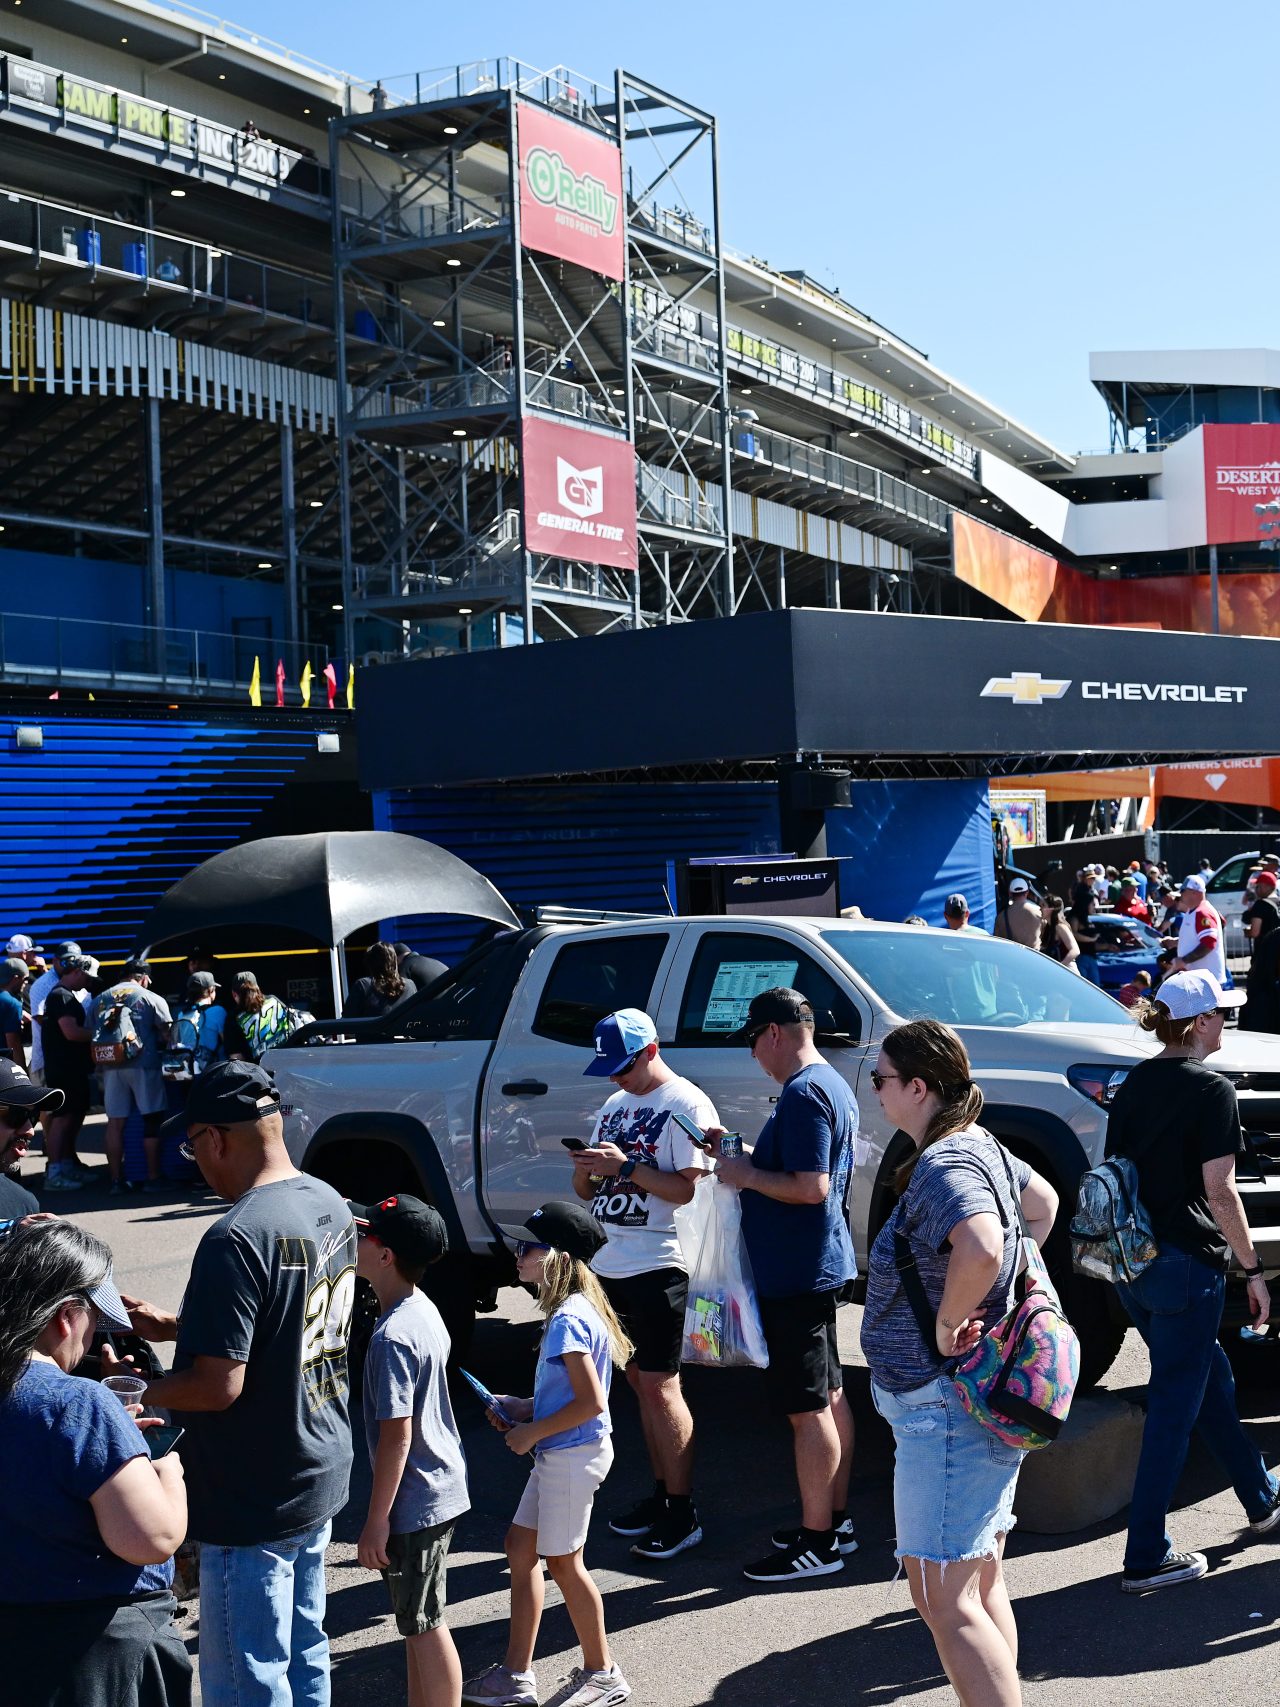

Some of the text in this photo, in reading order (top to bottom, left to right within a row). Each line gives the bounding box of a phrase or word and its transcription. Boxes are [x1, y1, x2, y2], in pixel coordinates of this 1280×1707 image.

[245, 141, 290, 180] 2009
[531, 155, 613, 227] O'Reilly
[1236, 486, 1267, 495] WEST
[538, 512, 624, 541] GENERAL TIRE
[1082, 681, 1248, 703] CHEVROLET
[1223, 759, 1262, 769] CIRCLE
[763, 873, 828, 883] CHEVROLET
[592, 1193, 651, 1216] RON
[316, 1214, 332, 1227] JGR
[303, 1264, 356, 1362] 20
